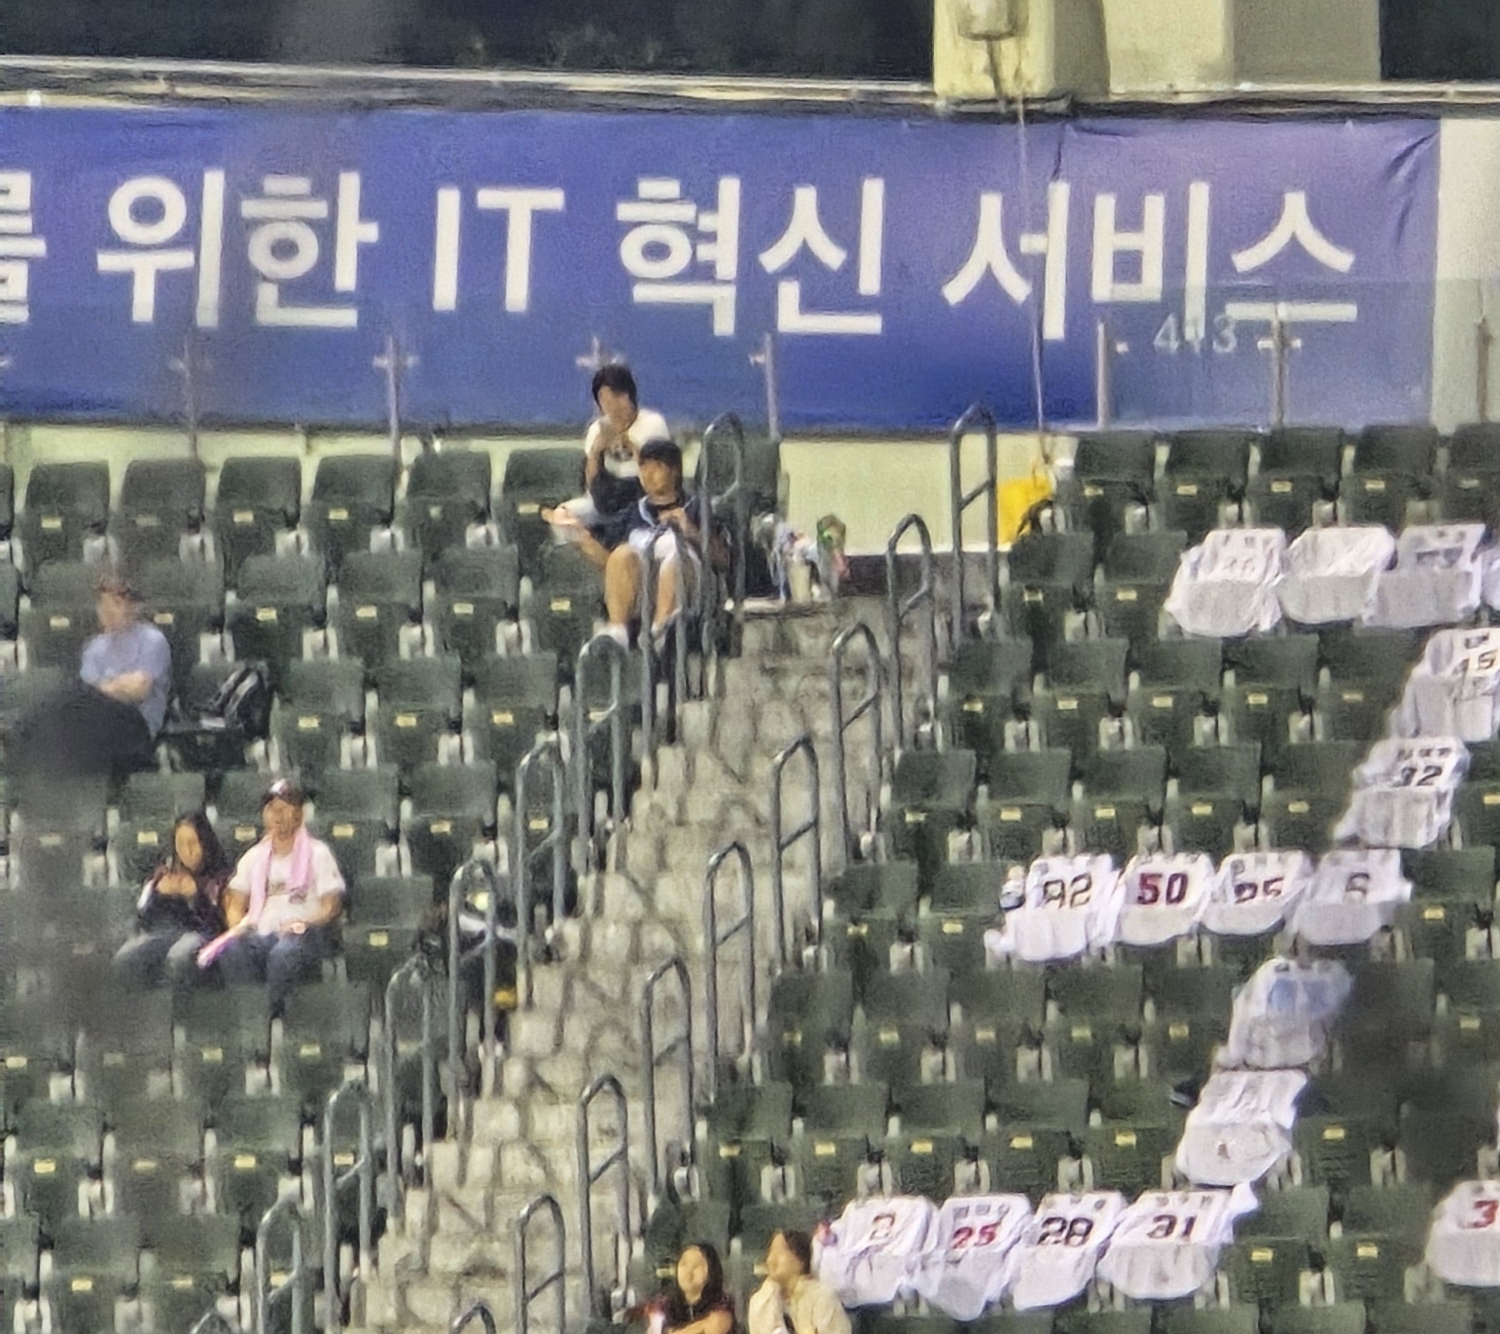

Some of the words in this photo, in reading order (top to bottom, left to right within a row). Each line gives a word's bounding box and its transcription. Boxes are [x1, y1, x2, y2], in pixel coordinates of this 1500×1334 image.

[97, 170, 379, 328] 위한
[433, 186, 565, 312] IT
[616, 176, 885, 338] 혁신
[942, 179, 1358, 341] 서비스
[1136, 872, 1188, 907] 50
